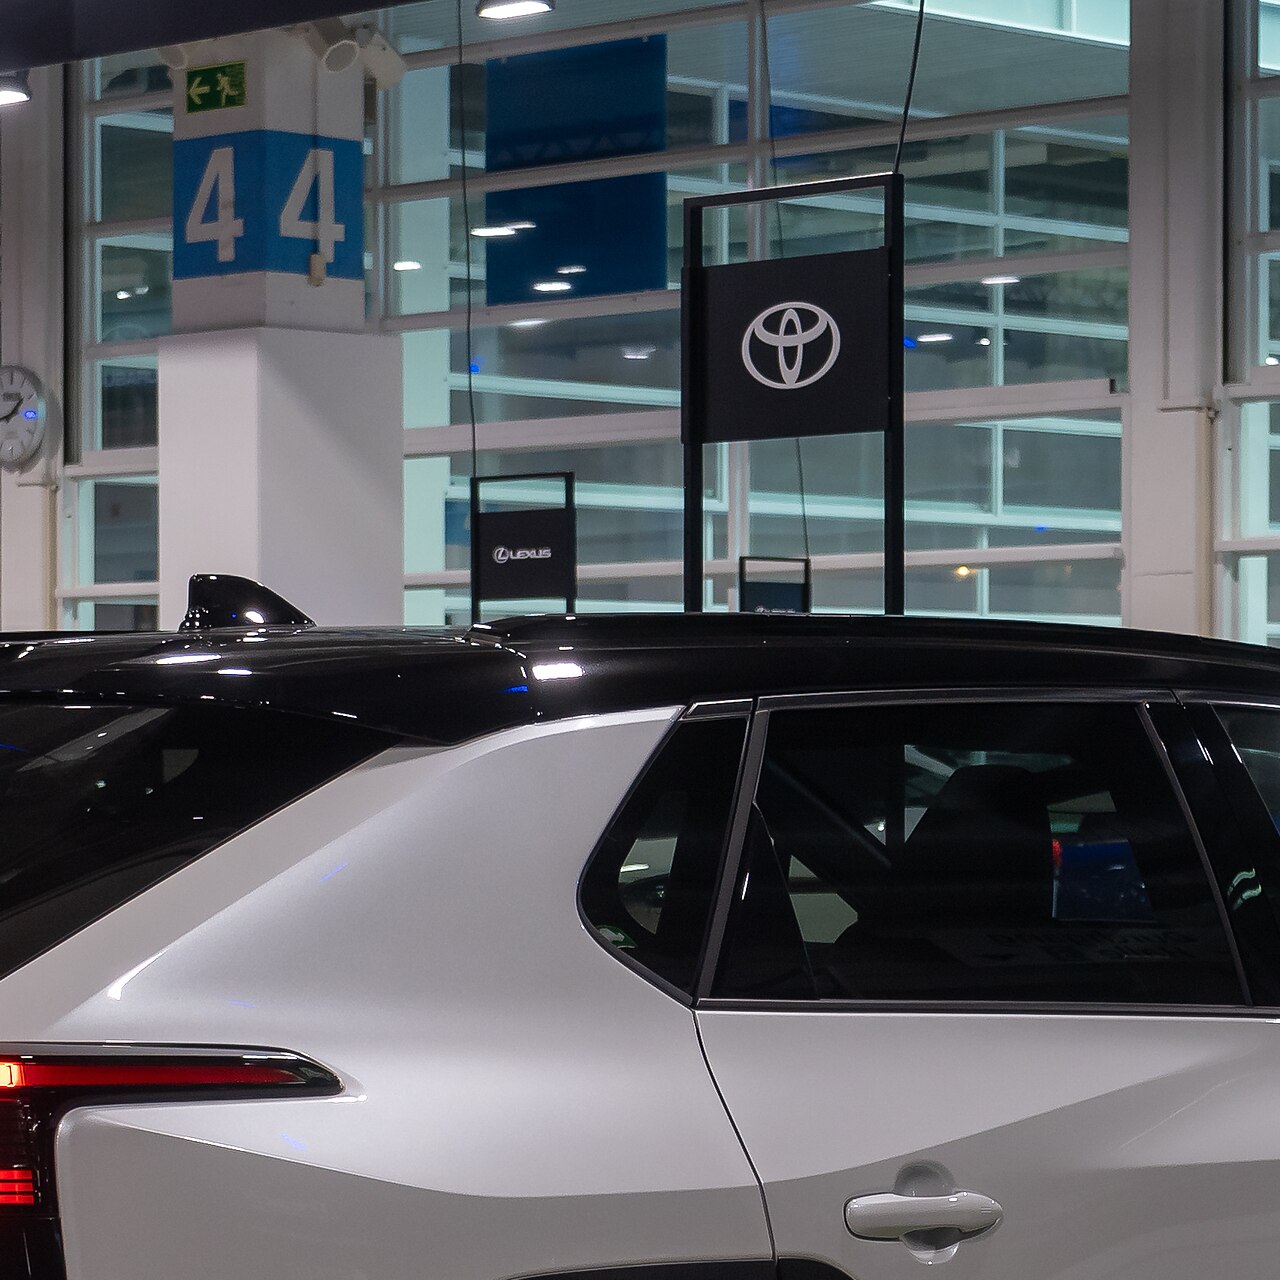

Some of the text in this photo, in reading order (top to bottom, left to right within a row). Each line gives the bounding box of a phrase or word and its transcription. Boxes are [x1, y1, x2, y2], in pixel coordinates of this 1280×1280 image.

[185, 146, 245, 263] 4
[279, 148, 346, 264] 4
[509, 547, 552, 560] LEXUS
